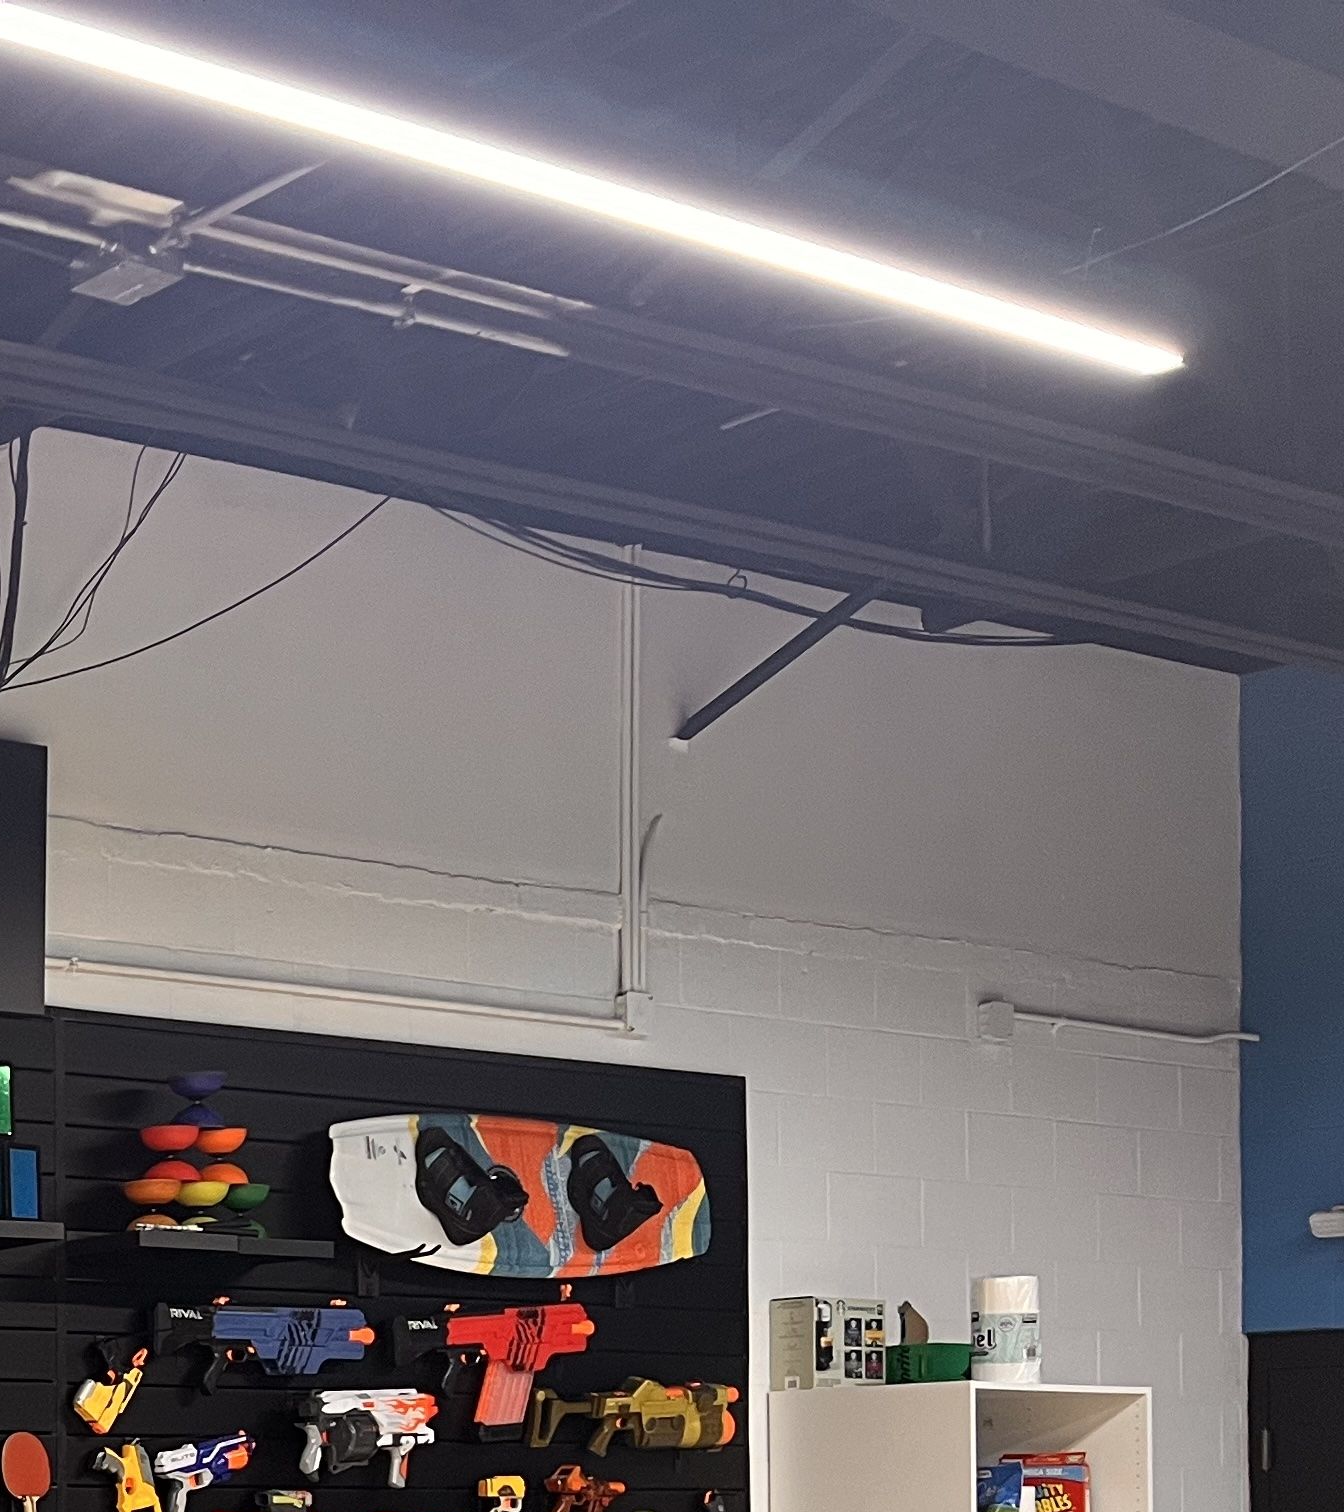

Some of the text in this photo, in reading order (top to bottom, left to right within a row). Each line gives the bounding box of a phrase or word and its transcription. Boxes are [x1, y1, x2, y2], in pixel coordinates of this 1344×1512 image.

[169, 1307, 204, 1320] RIVAL
[407, 1319, 439, 1331] RIVAL
[972, 1329, 994, 1347] el
